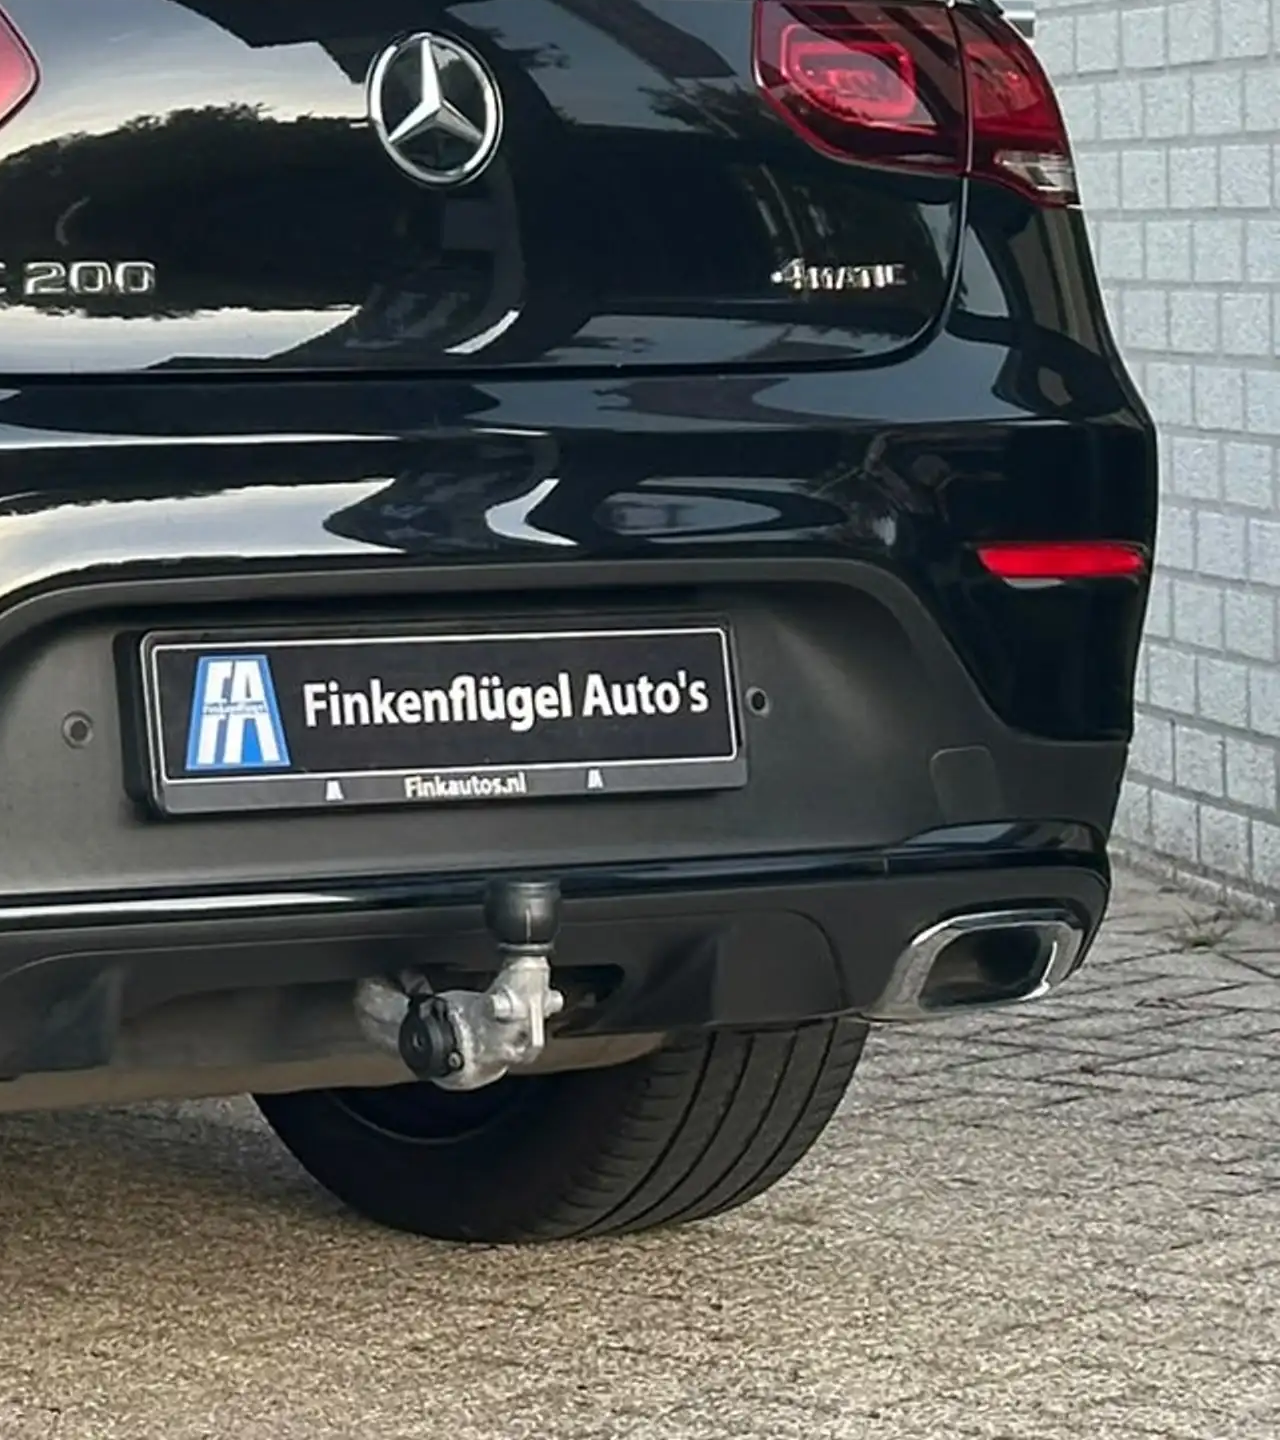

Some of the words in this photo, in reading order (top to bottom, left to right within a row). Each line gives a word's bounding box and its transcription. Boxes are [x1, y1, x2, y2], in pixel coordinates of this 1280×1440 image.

[24, 261, 155, 295] 200
[303, 671, 573, 733] Finkenflügel
[582, 669, 710, 718] Auto's
[403, 771, 527, 799] Finkautos.nl
